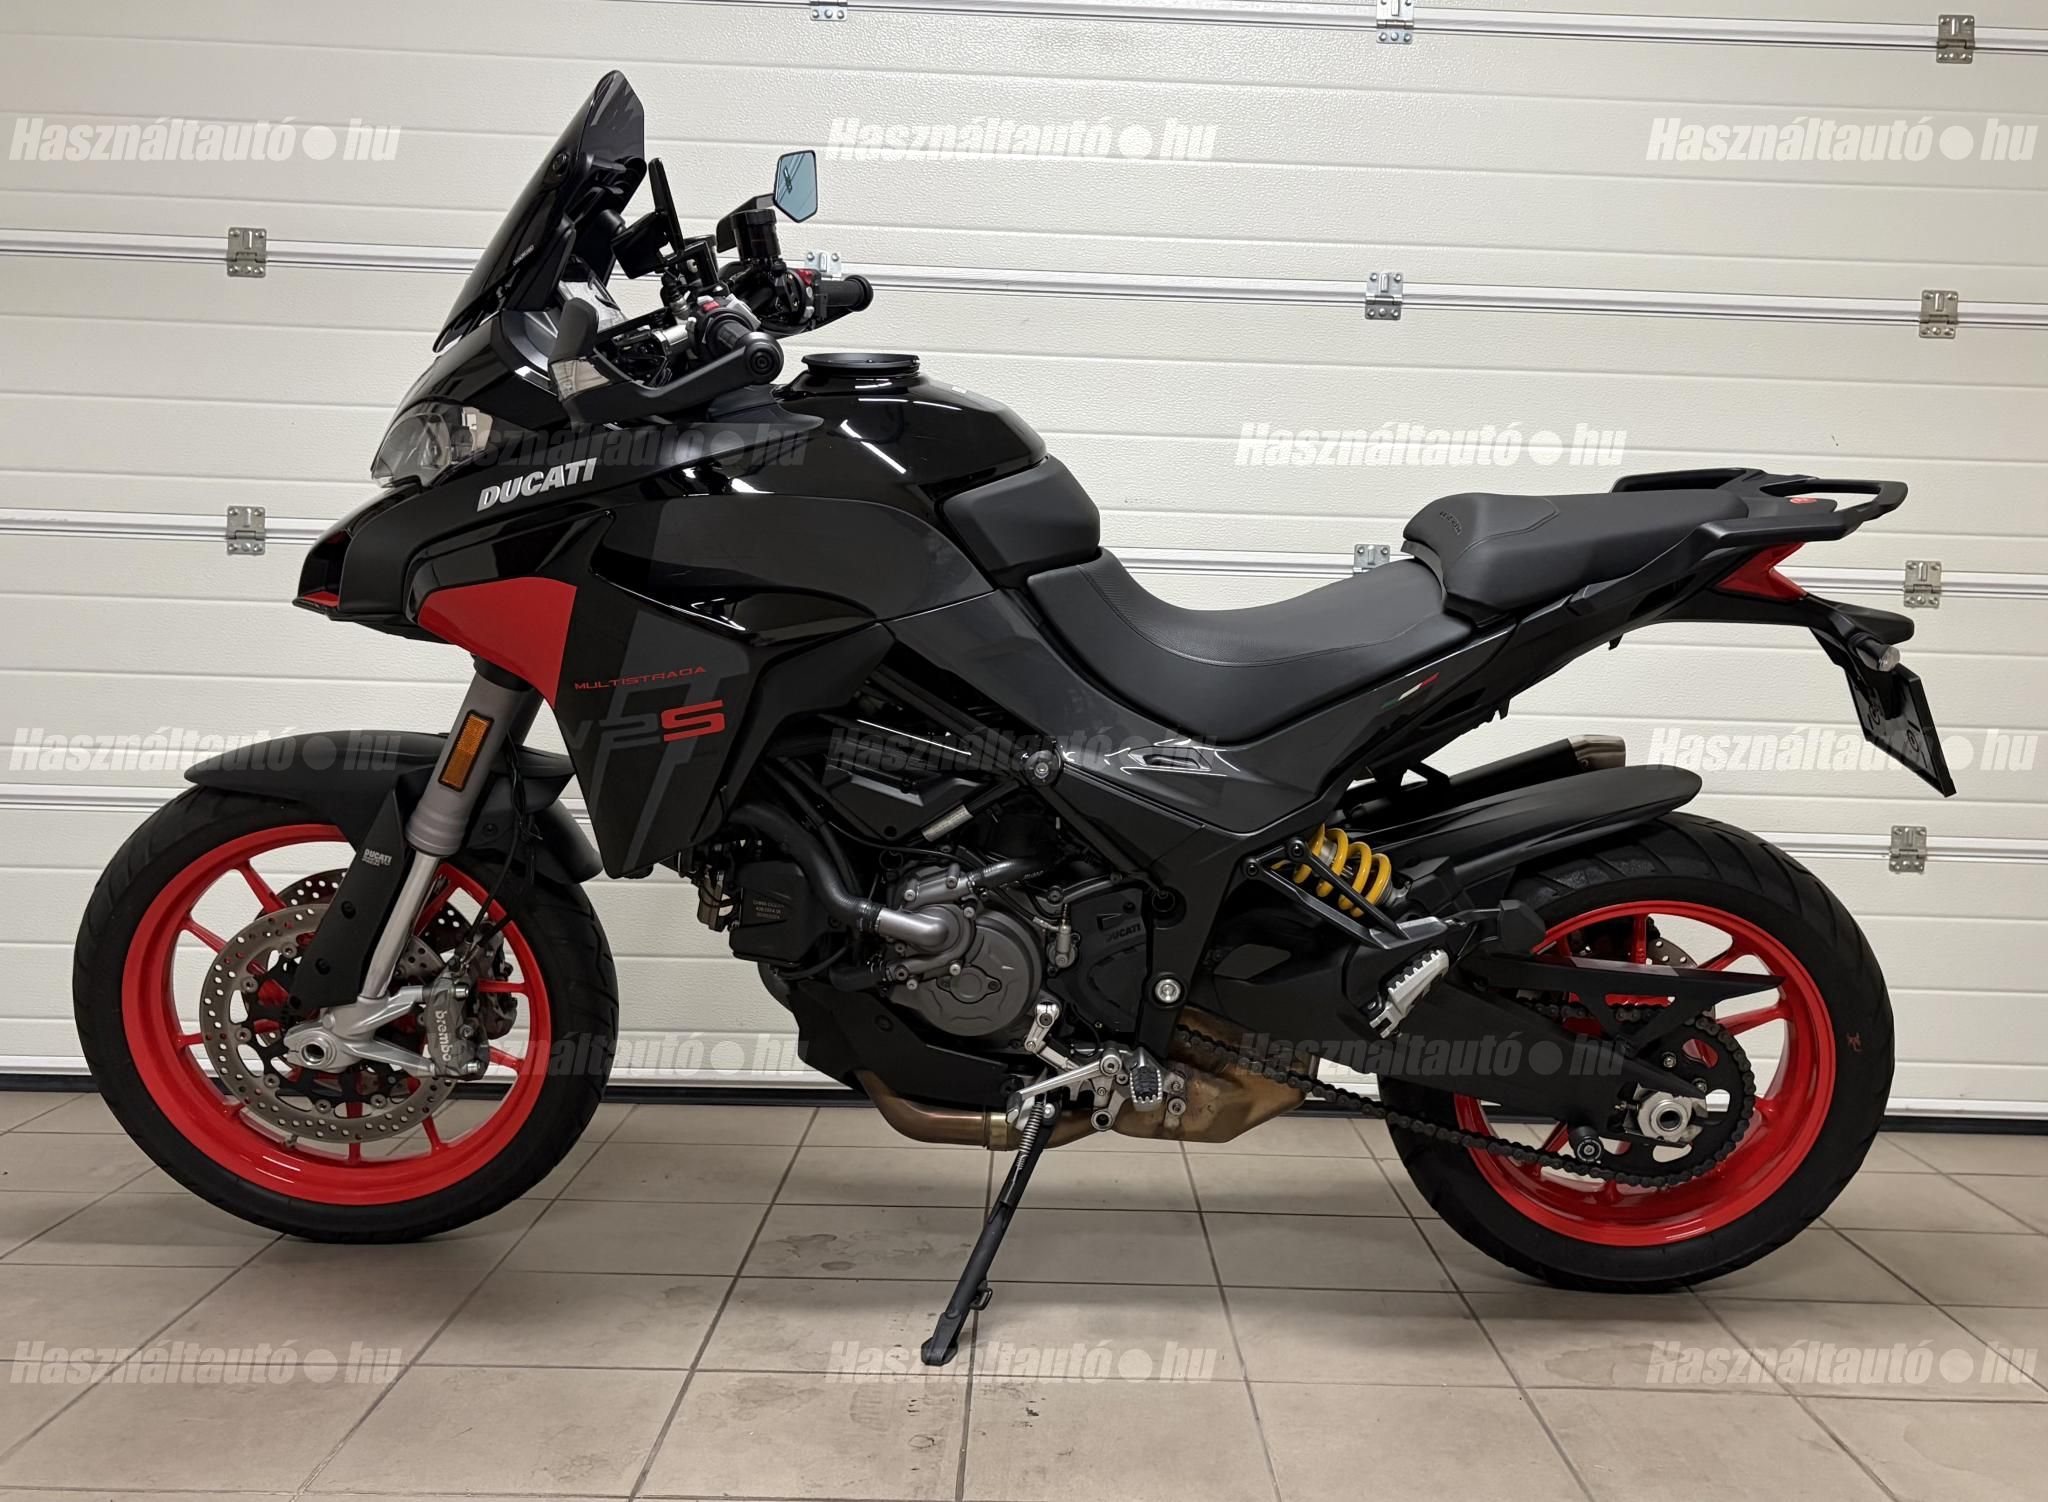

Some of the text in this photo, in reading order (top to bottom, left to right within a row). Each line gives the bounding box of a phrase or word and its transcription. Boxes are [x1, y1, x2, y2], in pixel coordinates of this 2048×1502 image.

[476, 457, 598, 512] DUCATI
[574, 665, 706, 691] MULTISTRADA
[435, 1009, 453, 1062] brembo
